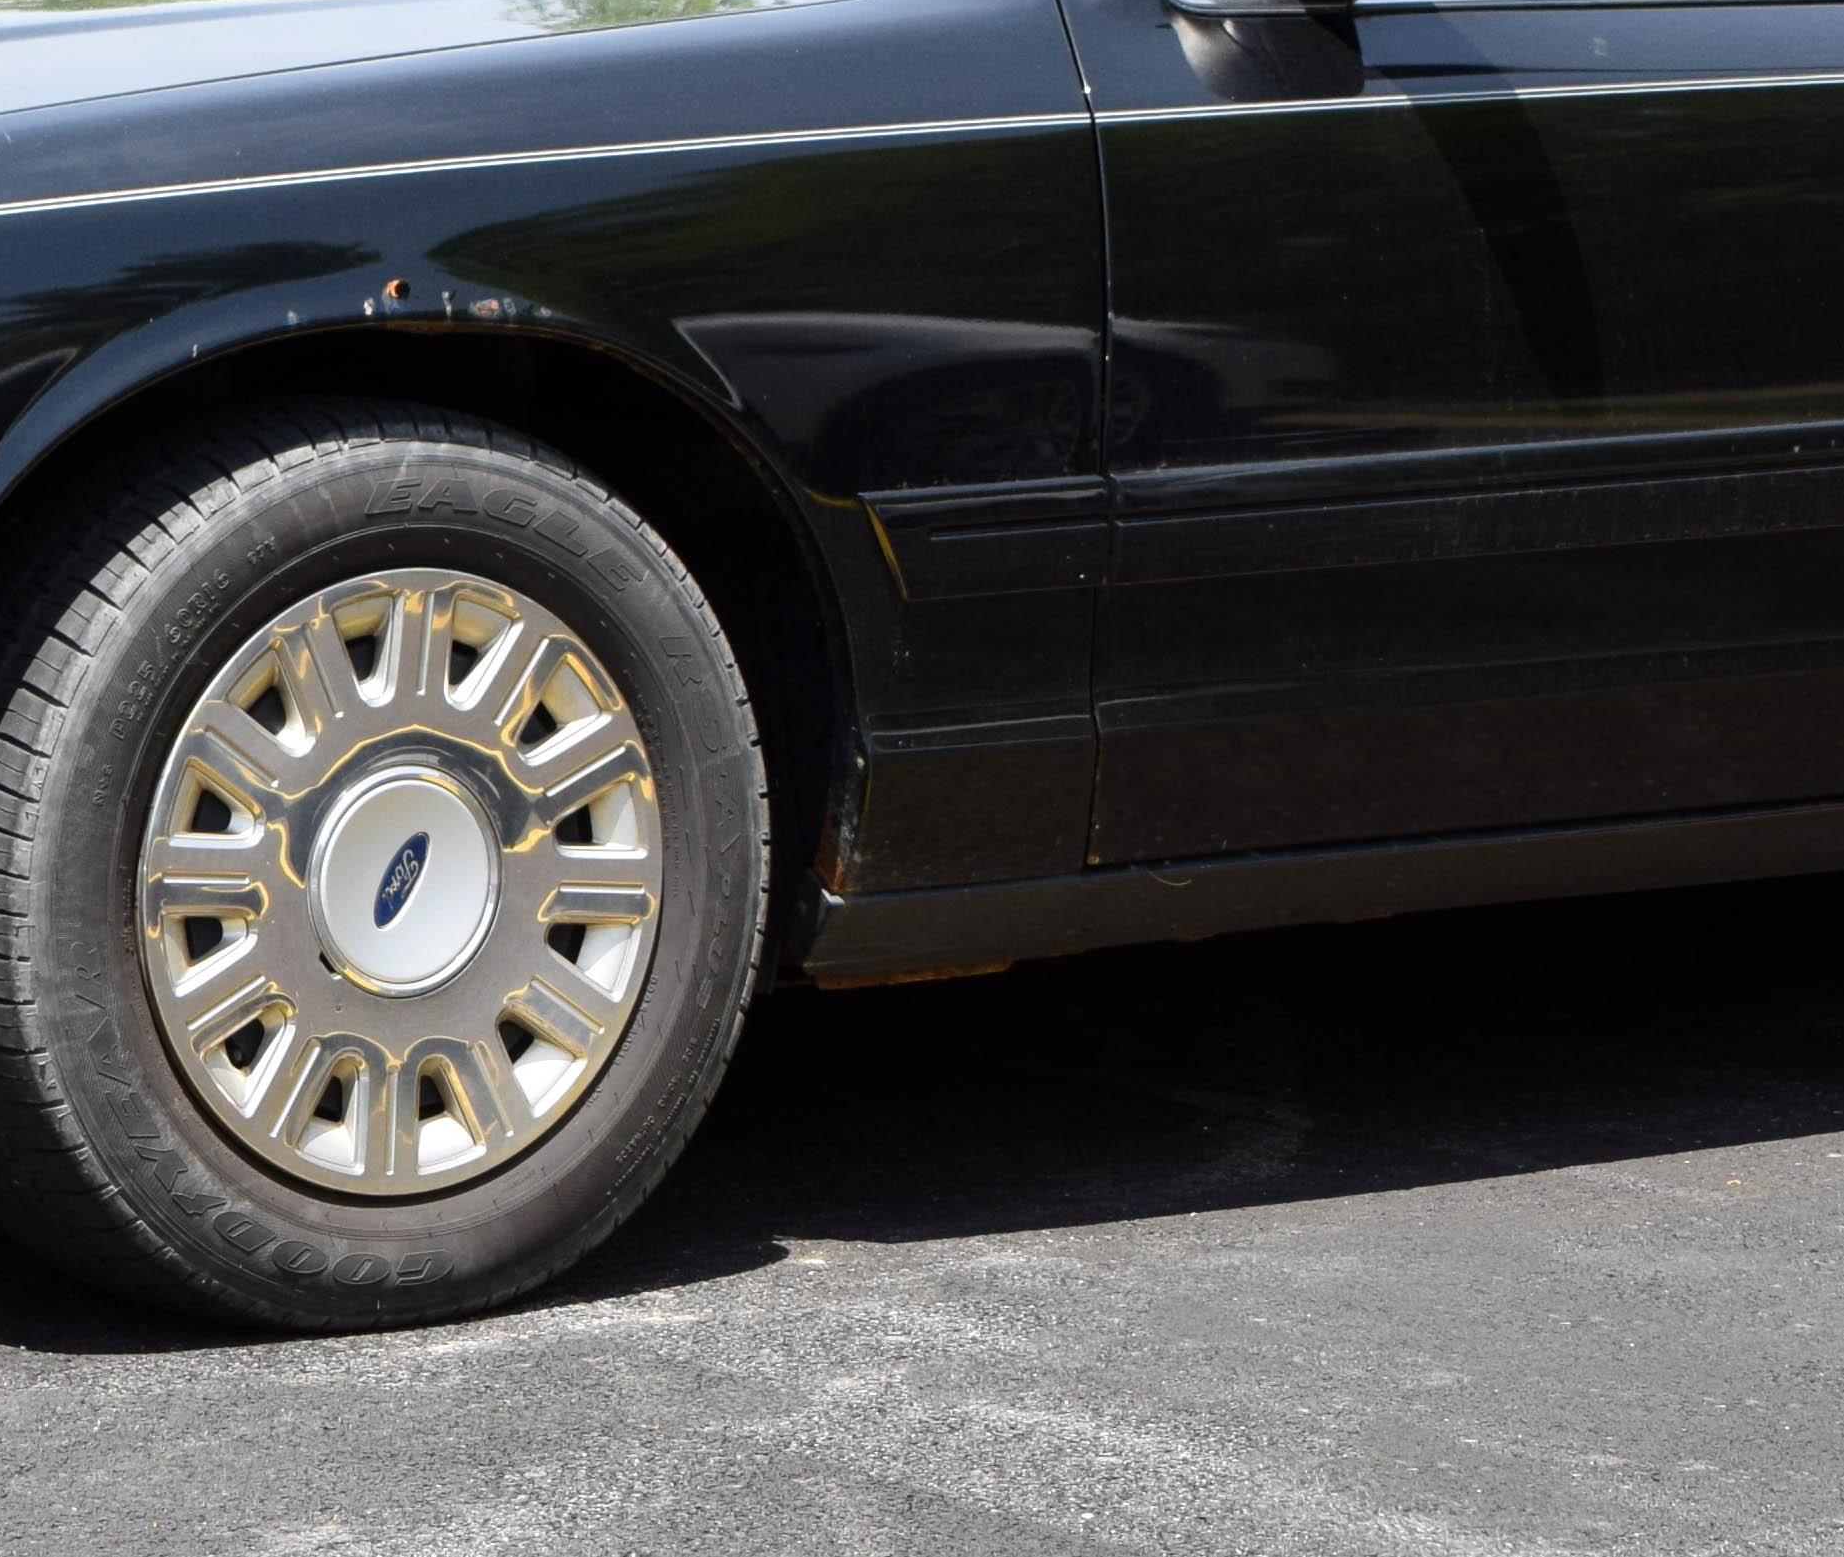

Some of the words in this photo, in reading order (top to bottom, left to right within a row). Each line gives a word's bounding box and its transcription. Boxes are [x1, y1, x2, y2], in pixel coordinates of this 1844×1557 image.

[364, 476, 651, 593] EAGLE
[379, 846, 422, 914] Ford
[70, 941, 455, 1287] GOODYEAR
